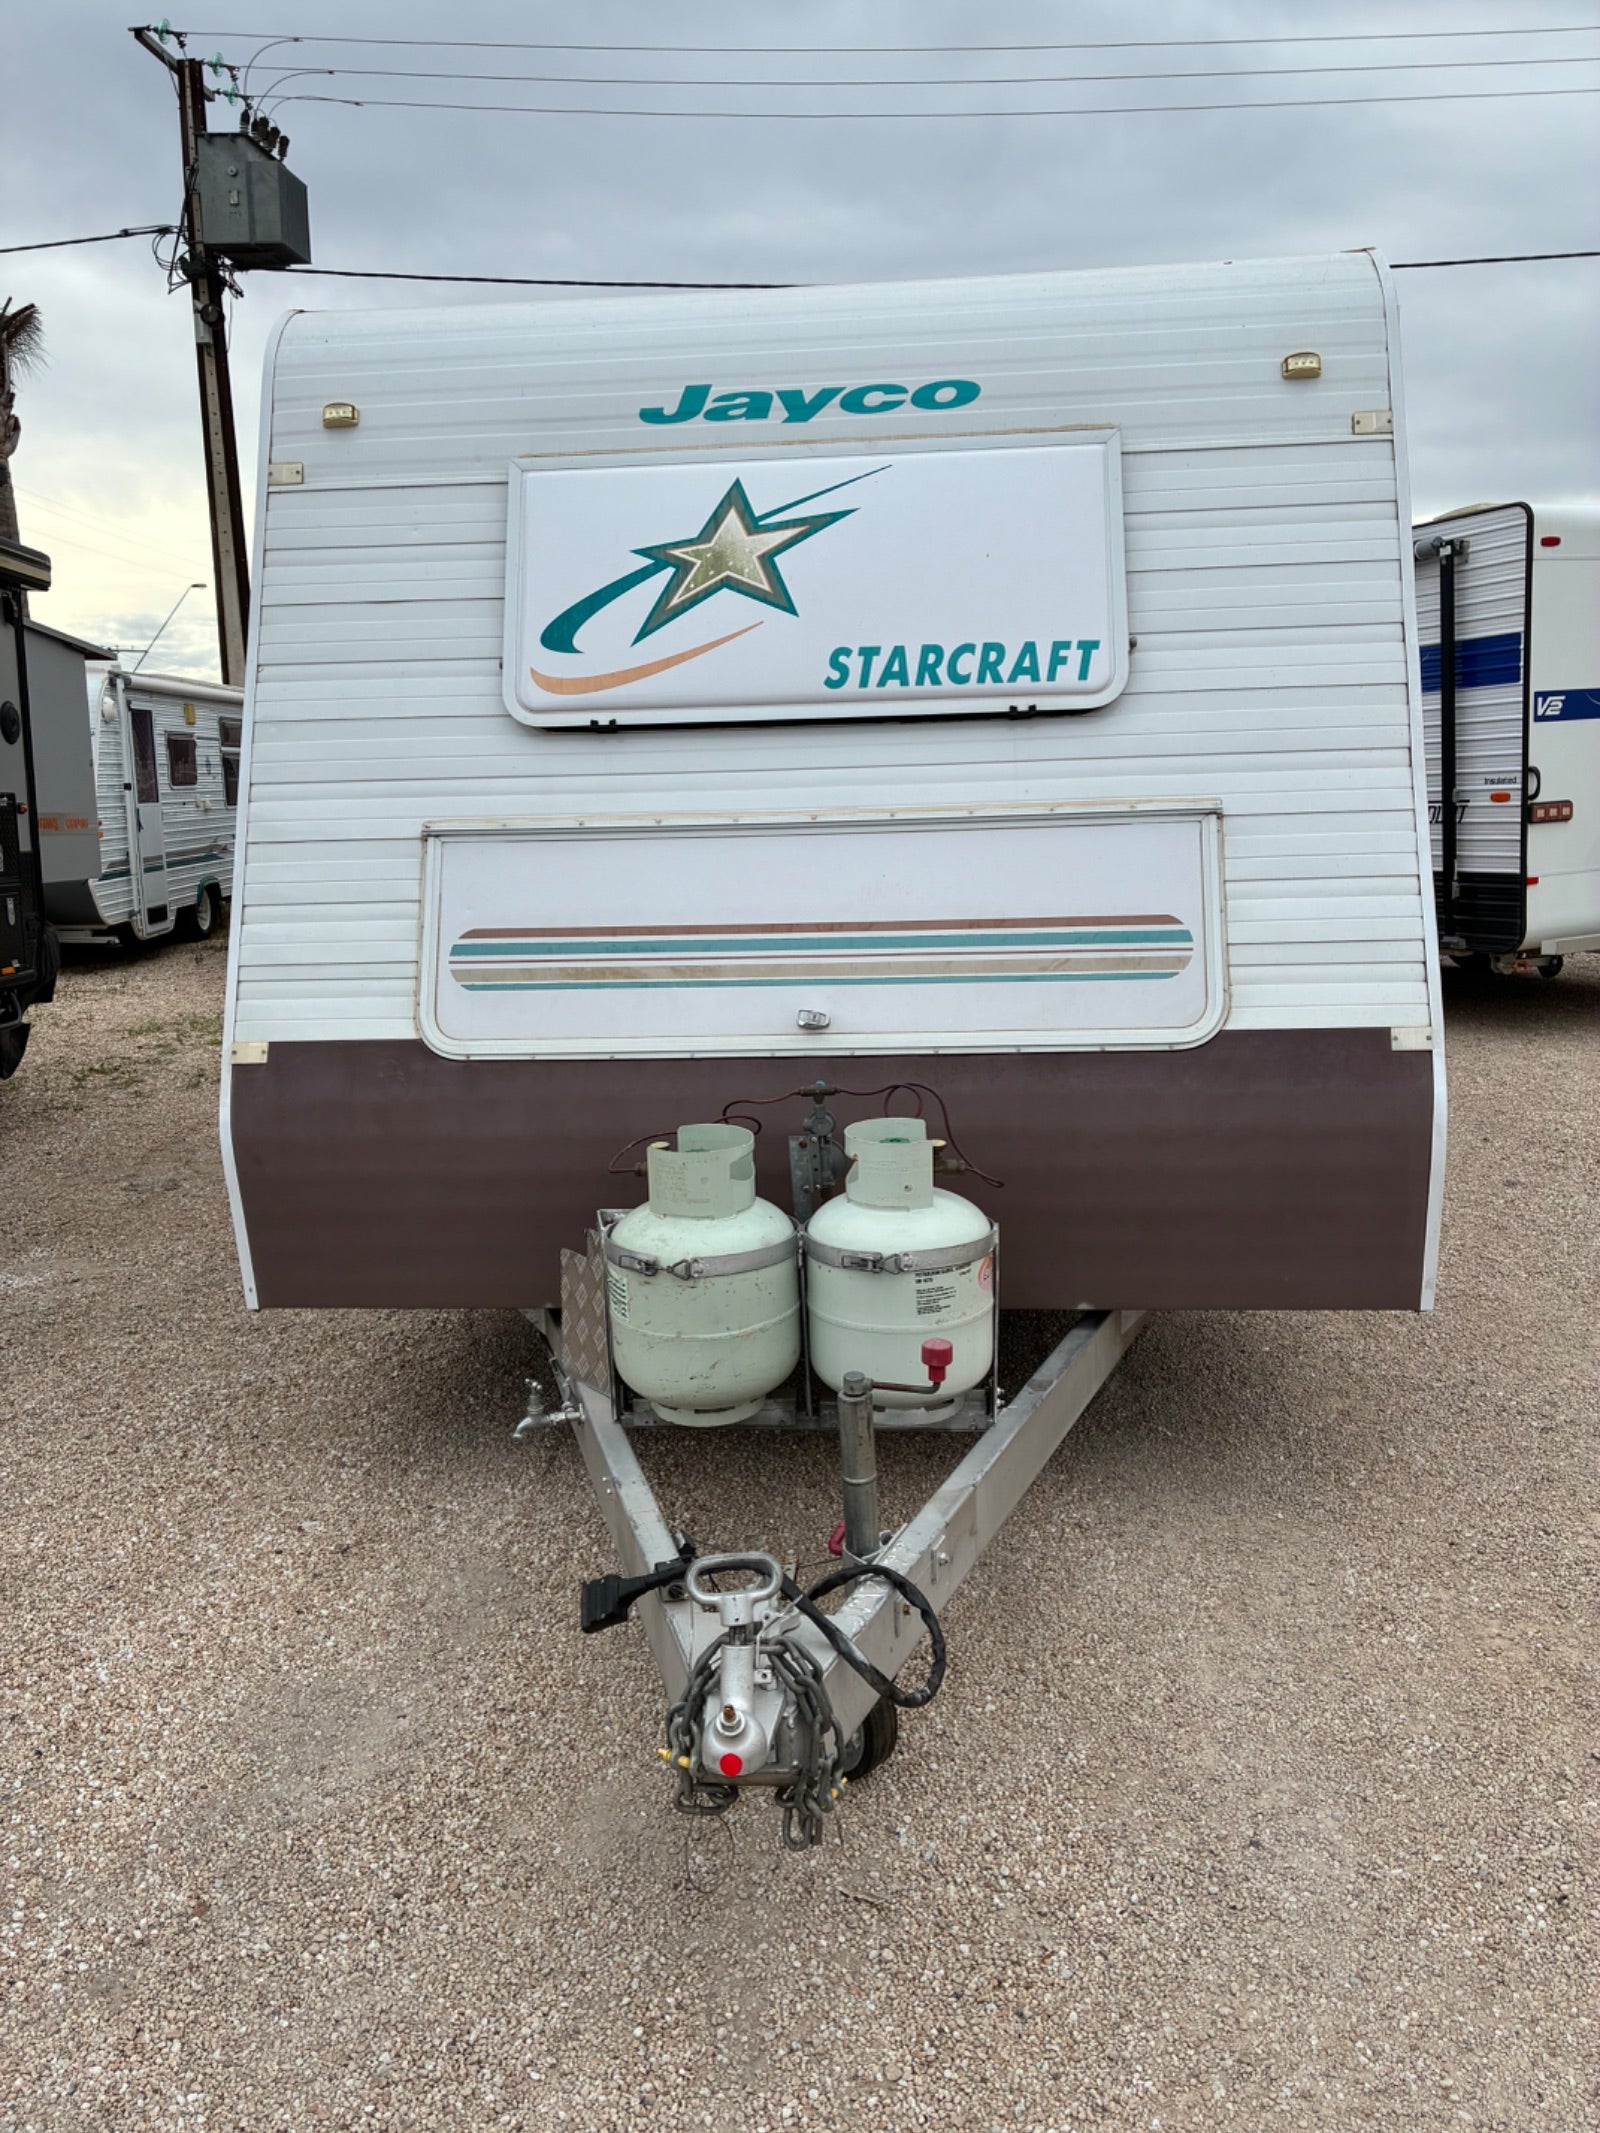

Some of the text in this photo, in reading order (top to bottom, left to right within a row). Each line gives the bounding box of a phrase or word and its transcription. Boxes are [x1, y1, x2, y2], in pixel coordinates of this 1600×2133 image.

[638, 379, 981, 425] Jayco
[823, 639, 1101, 689] STARCRAFT
[1484, 776, 1518, 785] Insulated
